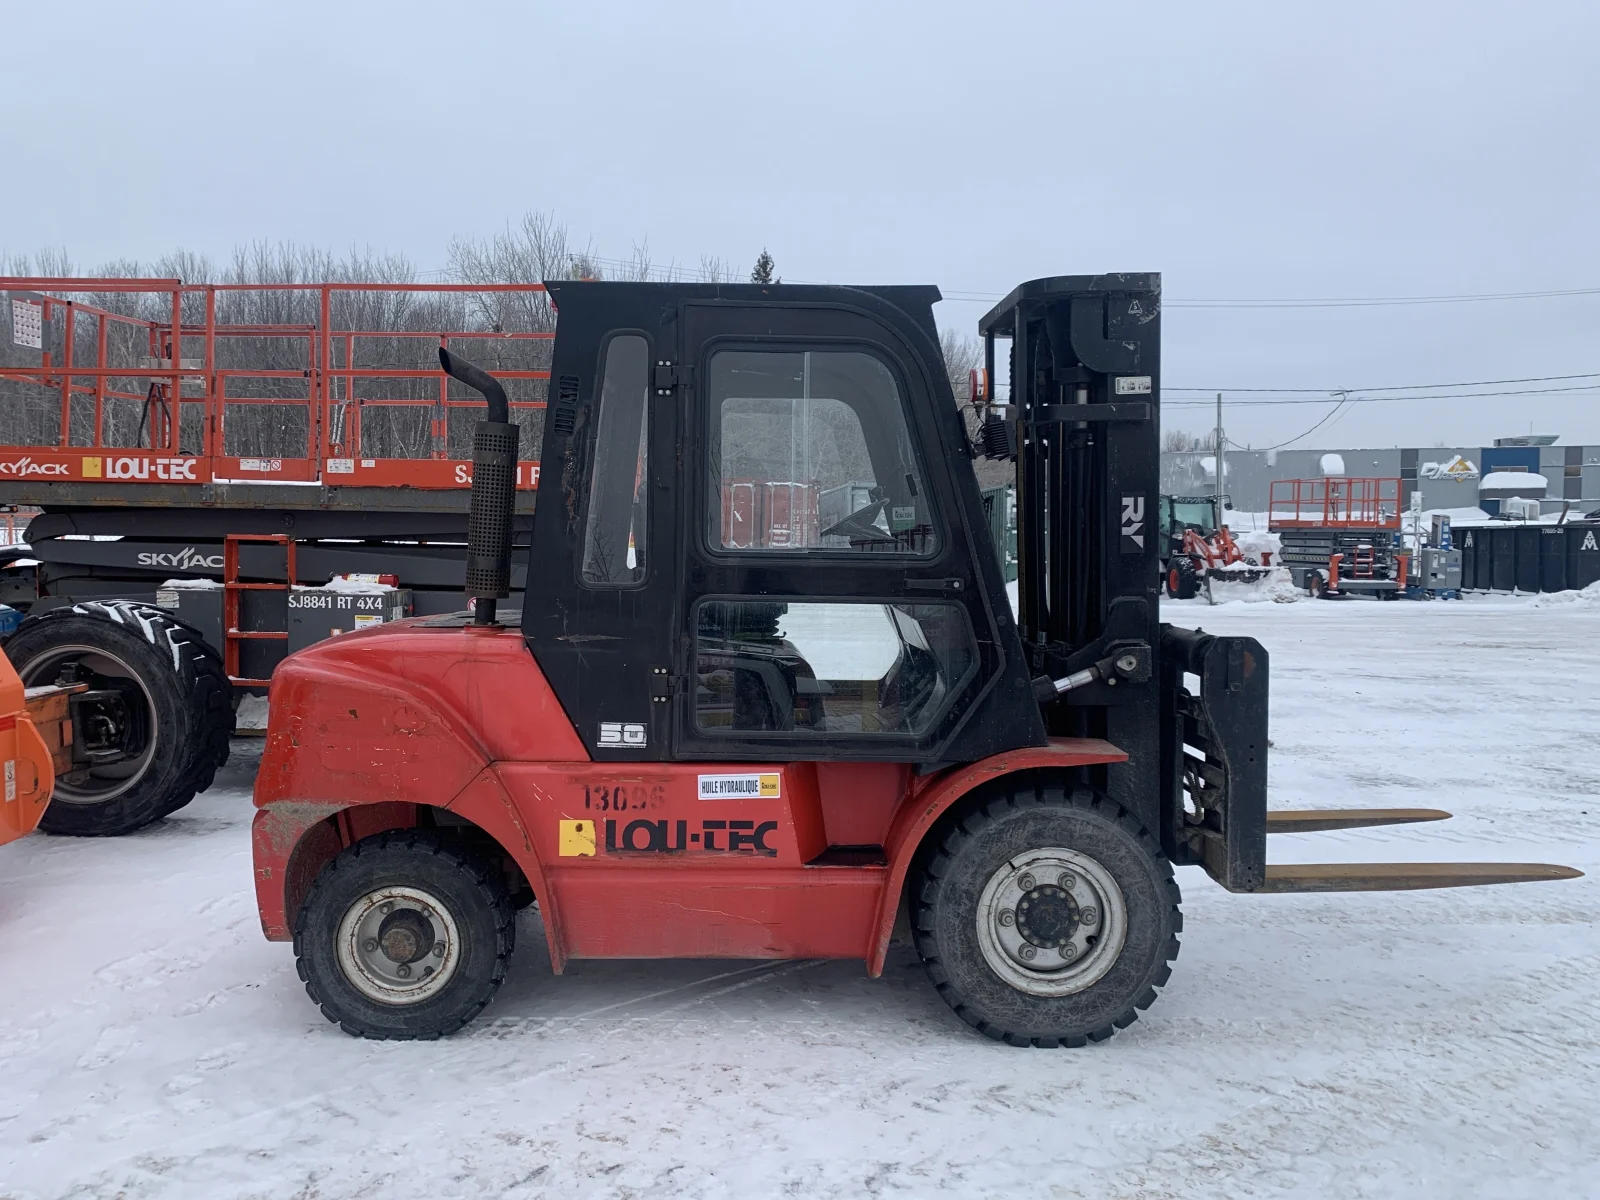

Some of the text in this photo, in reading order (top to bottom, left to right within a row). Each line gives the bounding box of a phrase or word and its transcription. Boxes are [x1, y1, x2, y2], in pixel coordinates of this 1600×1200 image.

[0, 457, 69, 476] KYJACK
[106, 457, 197, 480] LOU-TEC
[138, 547, 226, 570] SKYJAC
[288, 595, 383, 610] SJ8841 RT 4X4
[701, 781, 719, 794] HUILE
[720, 779, 759, 794] HYDRAULIQUE
[606, 819, 778, 857] LOU-TEC
